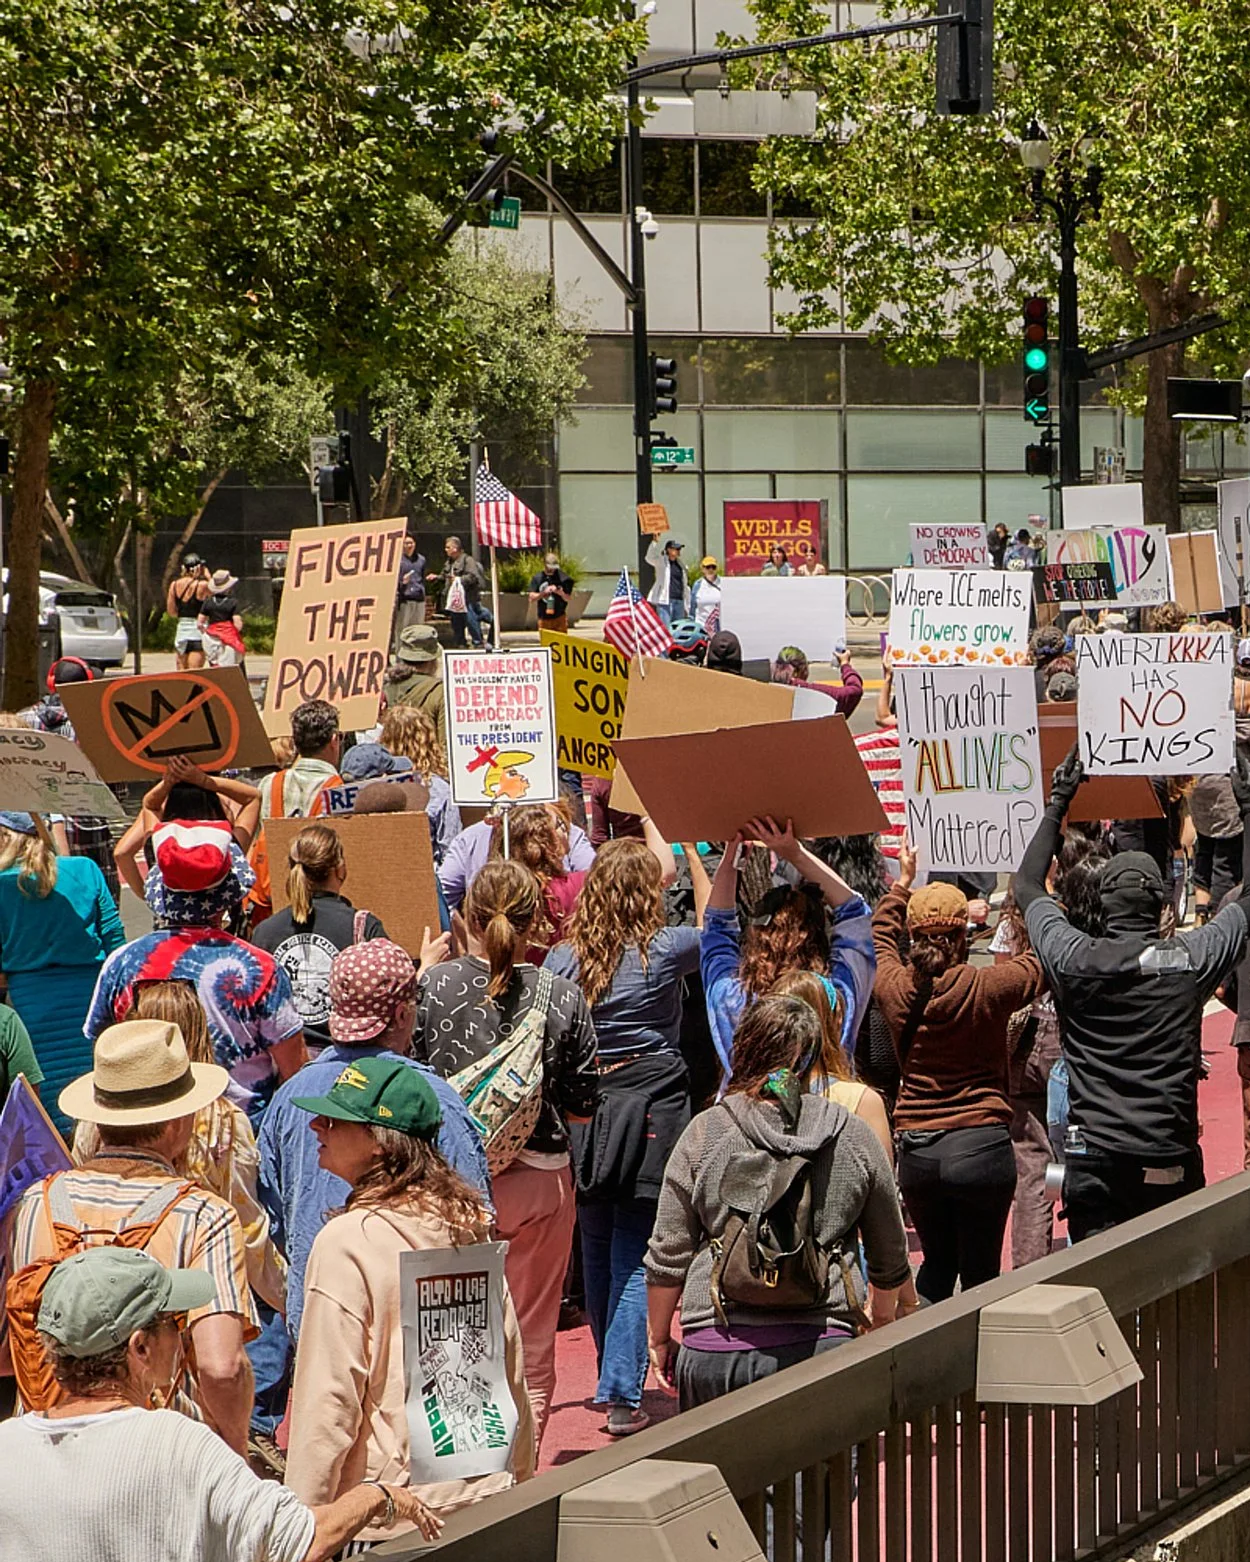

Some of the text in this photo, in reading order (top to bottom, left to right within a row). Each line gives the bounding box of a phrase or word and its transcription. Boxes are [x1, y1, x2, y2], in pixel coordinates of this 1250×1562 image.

[731, 520, 812, 537] WELLS
[917, 527, 981, 539] NO CROWNS
[936, 538, 959, 549] IN A
[294, 530, 404, 588] FIGHT
[734, 539, 812, 557] FARGO
[924, 547, 986, 565] DEMOCRACY
[893, 572, 1027, 611] Where ICE melts,
[304, 598, 376, 642] THE
[910, 608, 1017, 647] flowers grow.
[453, 657, 542, 675] IN AMERICA
[1077, 634, 1229, 669] AMERIKKKA
[274, 651, 385, 710] POWER
[532, 674, 541, 682] TO
[1131, 669, 1179, 693] HAS
[454, 685, 539, 707] DEFEND
[901, 671, 1012, 733] I thought
[1120, 689, 1186, 733] NO
[456, 706, 543, 723] DEMOCRACY
[457, 731, 543, 746] THE PRESIDENT
[1085, 728, 1216, 769] KINGS
[908, 798, 1037, 867] Mattered?
[420, 1276, 487, 1308] ALTO A LAS
[419, 1300, 486, 1354] REDADAS!
